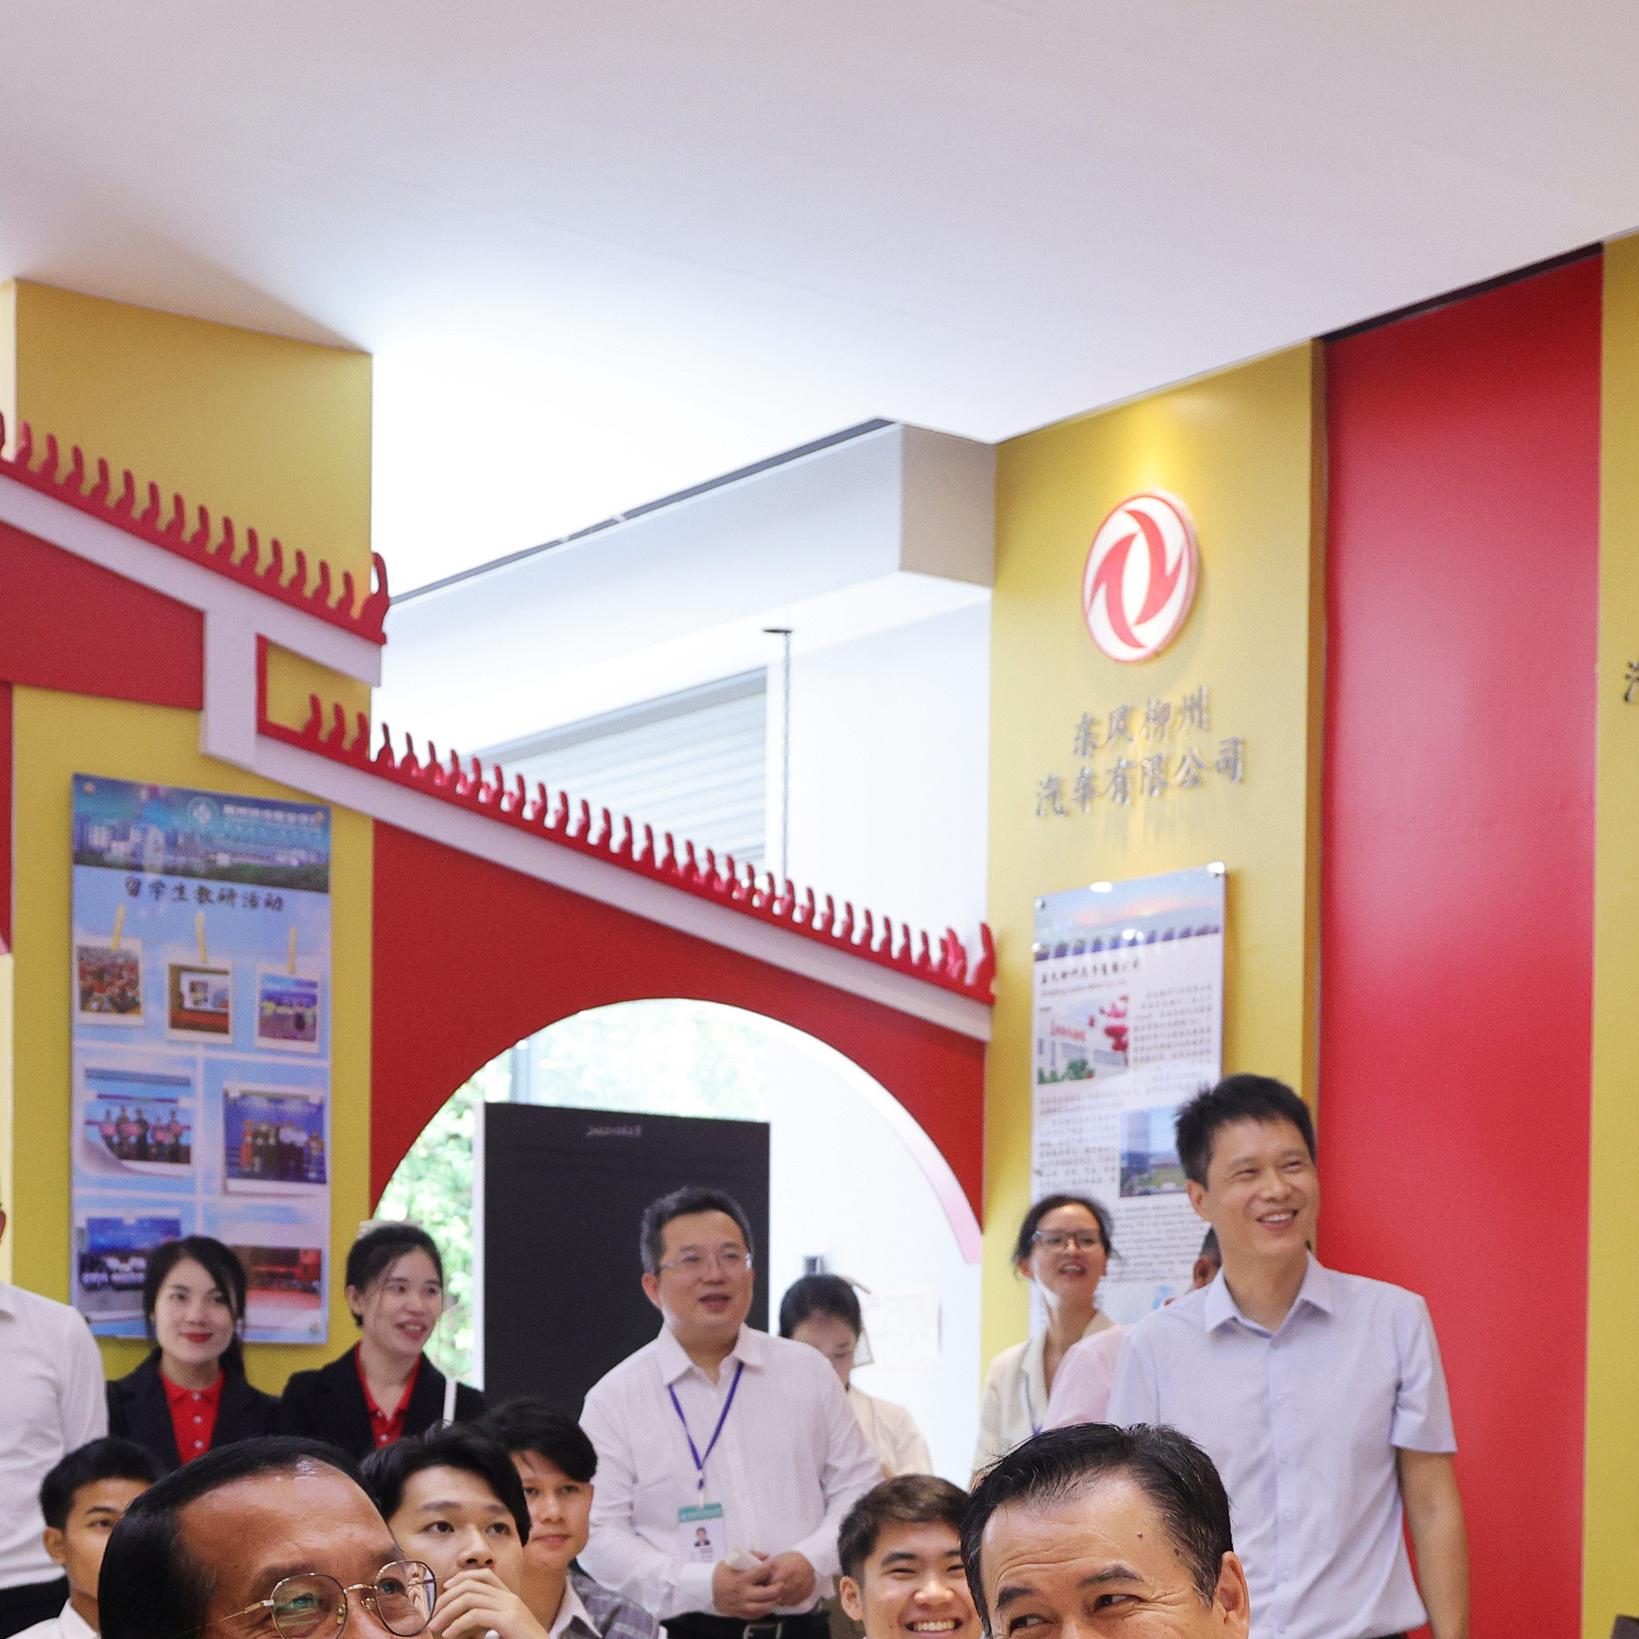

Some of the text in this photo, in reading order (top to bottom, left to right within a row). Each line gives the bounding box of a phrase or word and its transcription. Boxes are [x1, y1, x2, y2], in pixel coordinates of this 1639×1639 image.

[1074, 685, 1209, 758] 东风柳州
[1036, 736, 1246, 817] 汽车有限公司
[125, 876, 283, 911] 留学生教研活动
